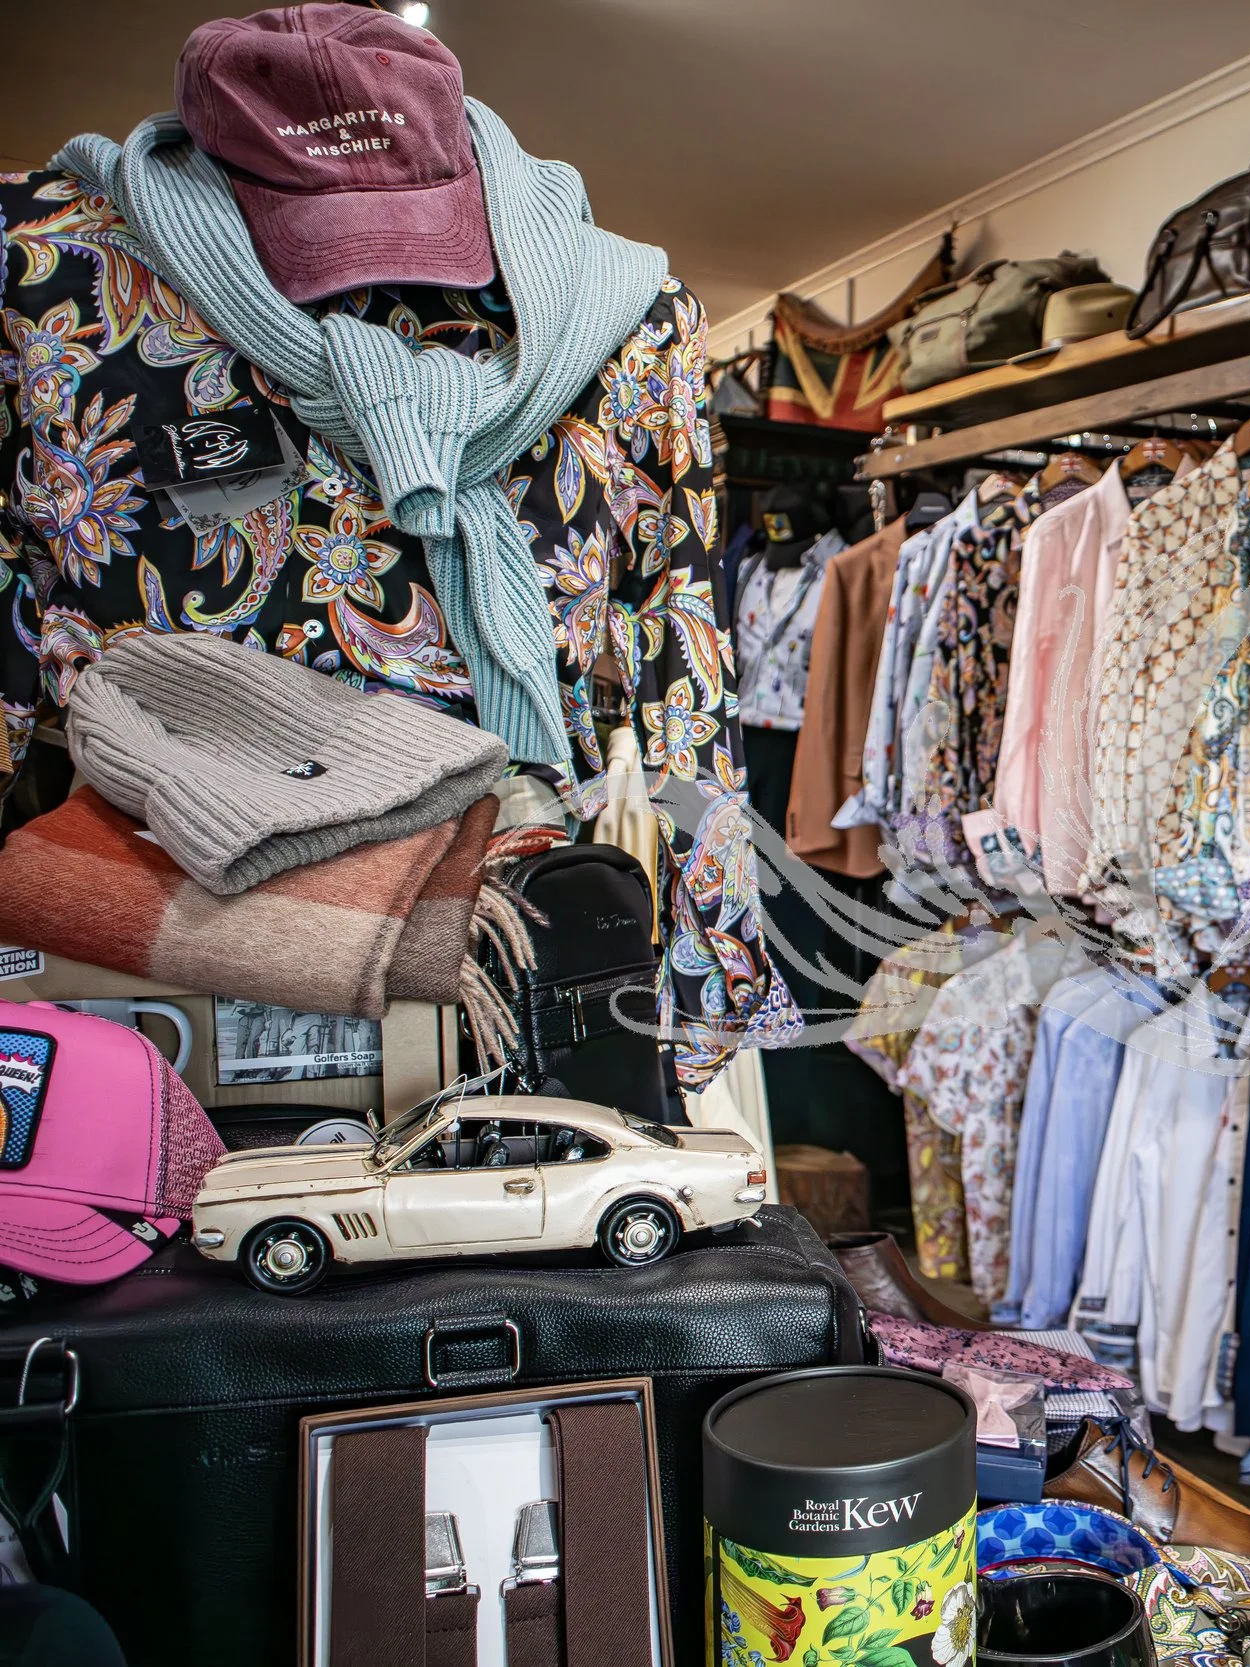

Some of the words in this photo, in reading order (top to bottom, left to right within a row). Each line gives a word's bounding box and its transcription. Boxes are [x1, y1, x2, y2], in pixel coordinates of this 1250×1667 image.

[276, 110, 406, 137] MARGARITAS
[339, 128, 352, 140] &
[306, 138, 391, 157] MISCHIEF
[314, 1054, 349, 1063] Golfers
[351, 1052, 375, 1063] Soap
[805, 1499, 839, 1513] Royal
[841, 1491, 923, 1531] Kew
[793, 1509, 840, 1521] Botanic
[788, 1520, 840, 1532] Gardens
